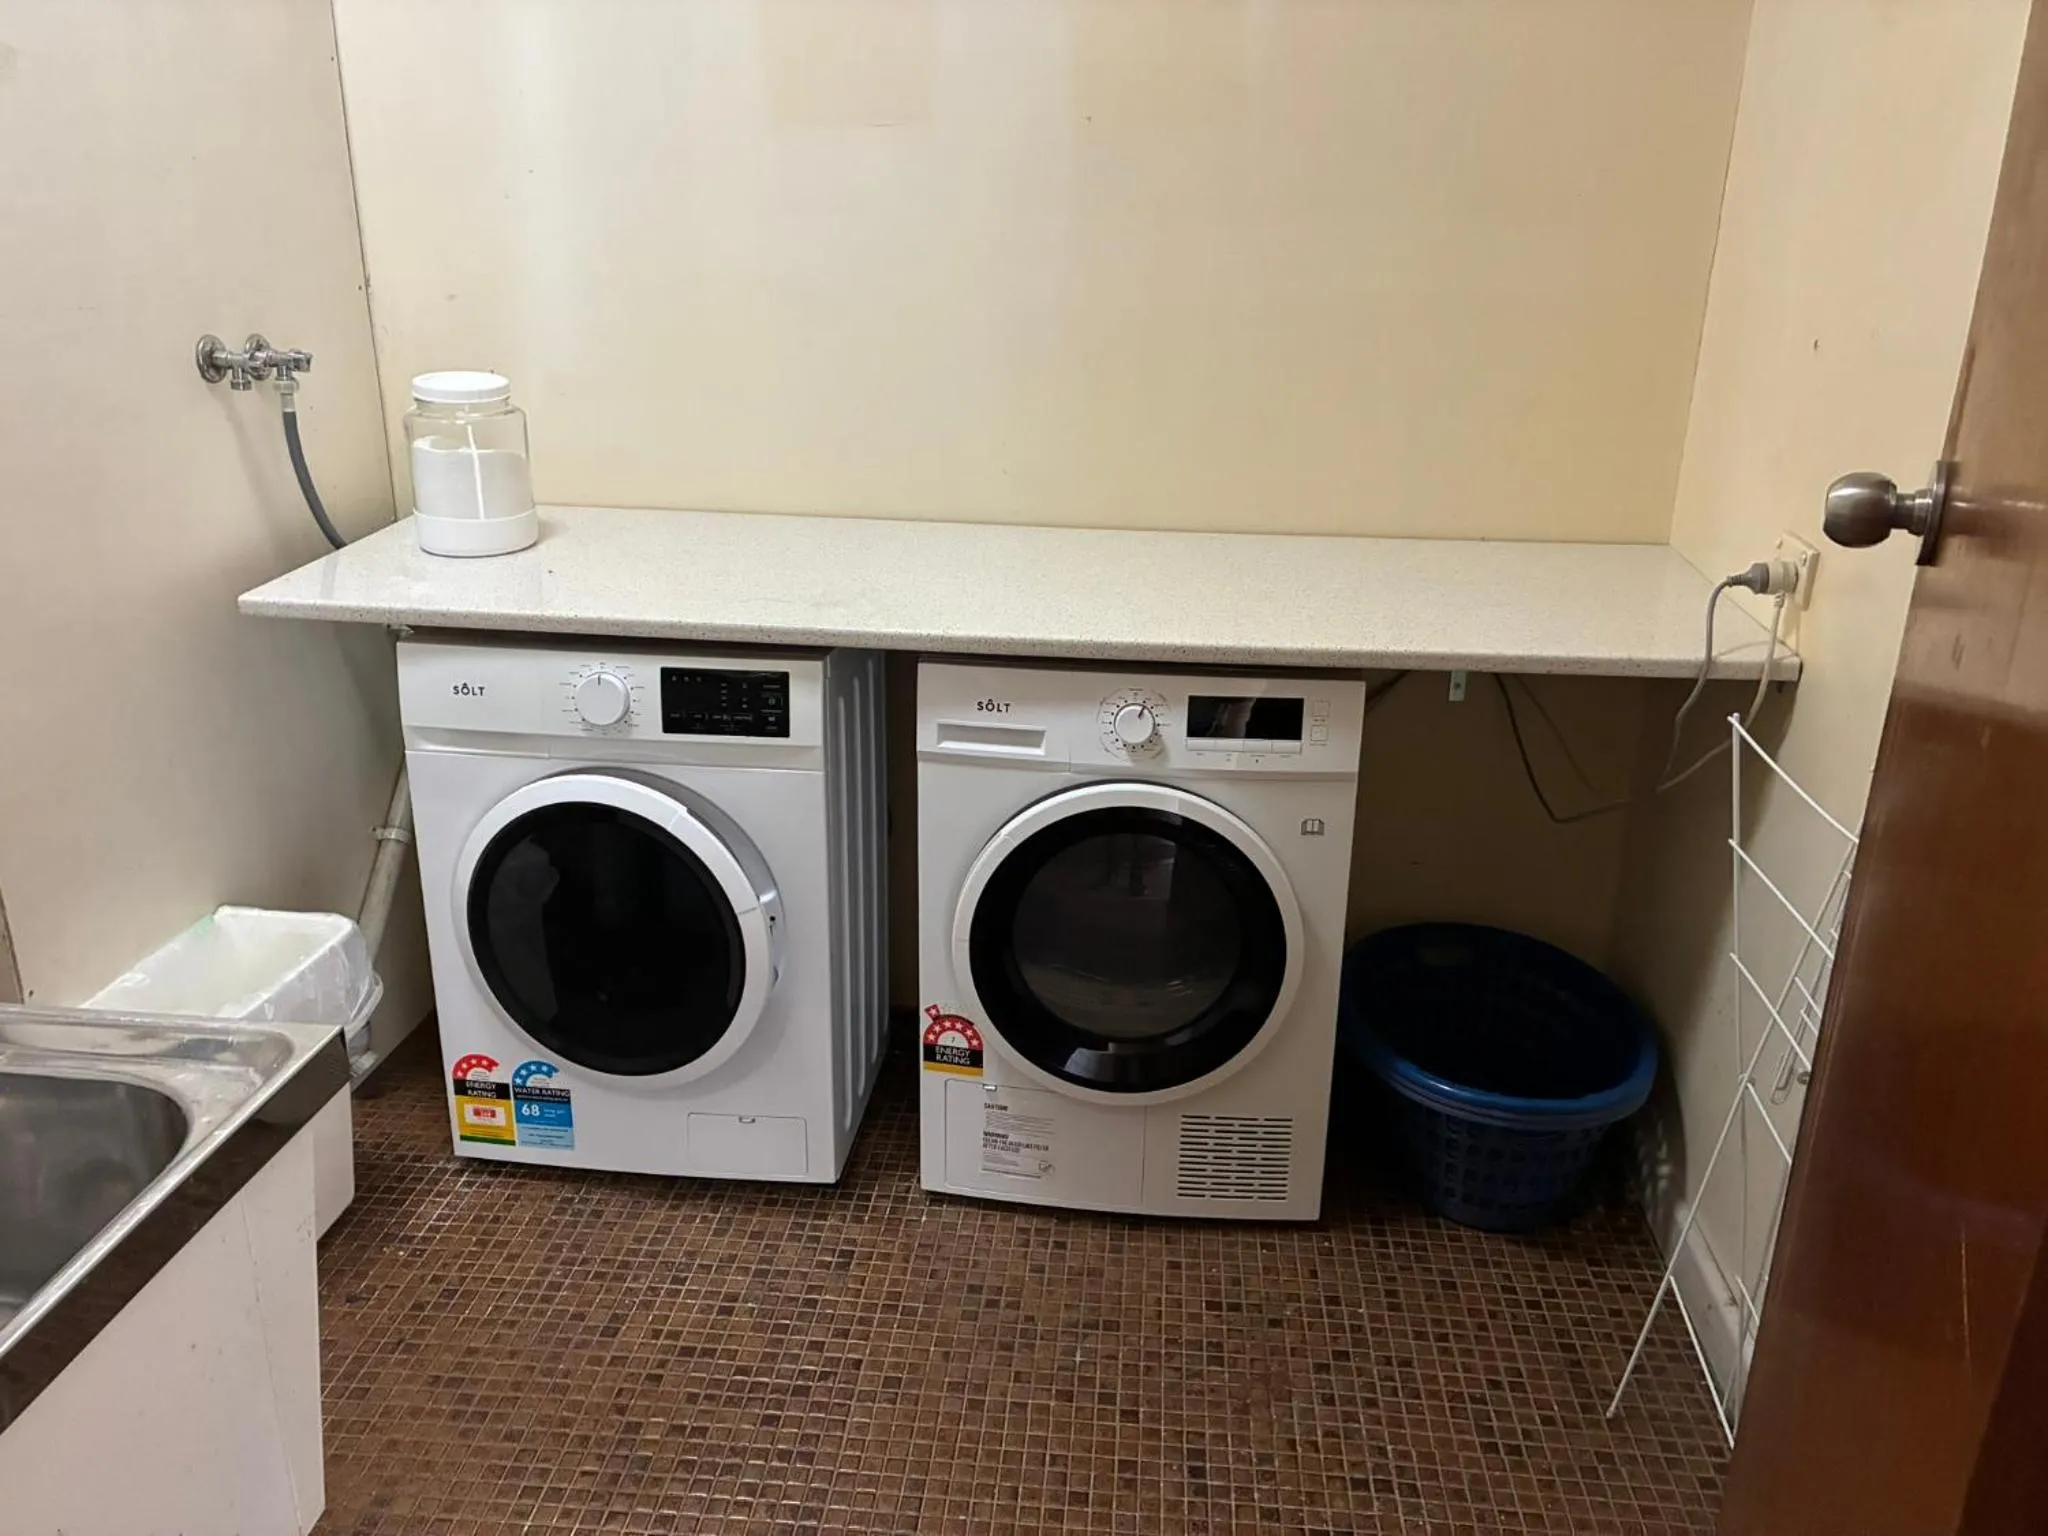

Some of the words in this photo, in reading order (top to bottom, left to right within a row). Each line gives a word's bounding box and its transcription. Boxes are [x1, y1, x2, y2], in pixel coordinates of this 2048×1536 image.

[453, 682, 485, 696] SÔLT
[977, 699, 1010, 713] SÔLT
[935, 1046, 971, 1056] ENERGY
[936, 1054, 970, 1065] RATING
[465, 1081, 496, 1090] ENERGY
[467, 1090, 497, 1099] RATING
[514, 1087, 540, 1095] WATER
[541, 1089, 570, 1097] RATING
[522, 1104, 540, 1117] 68
